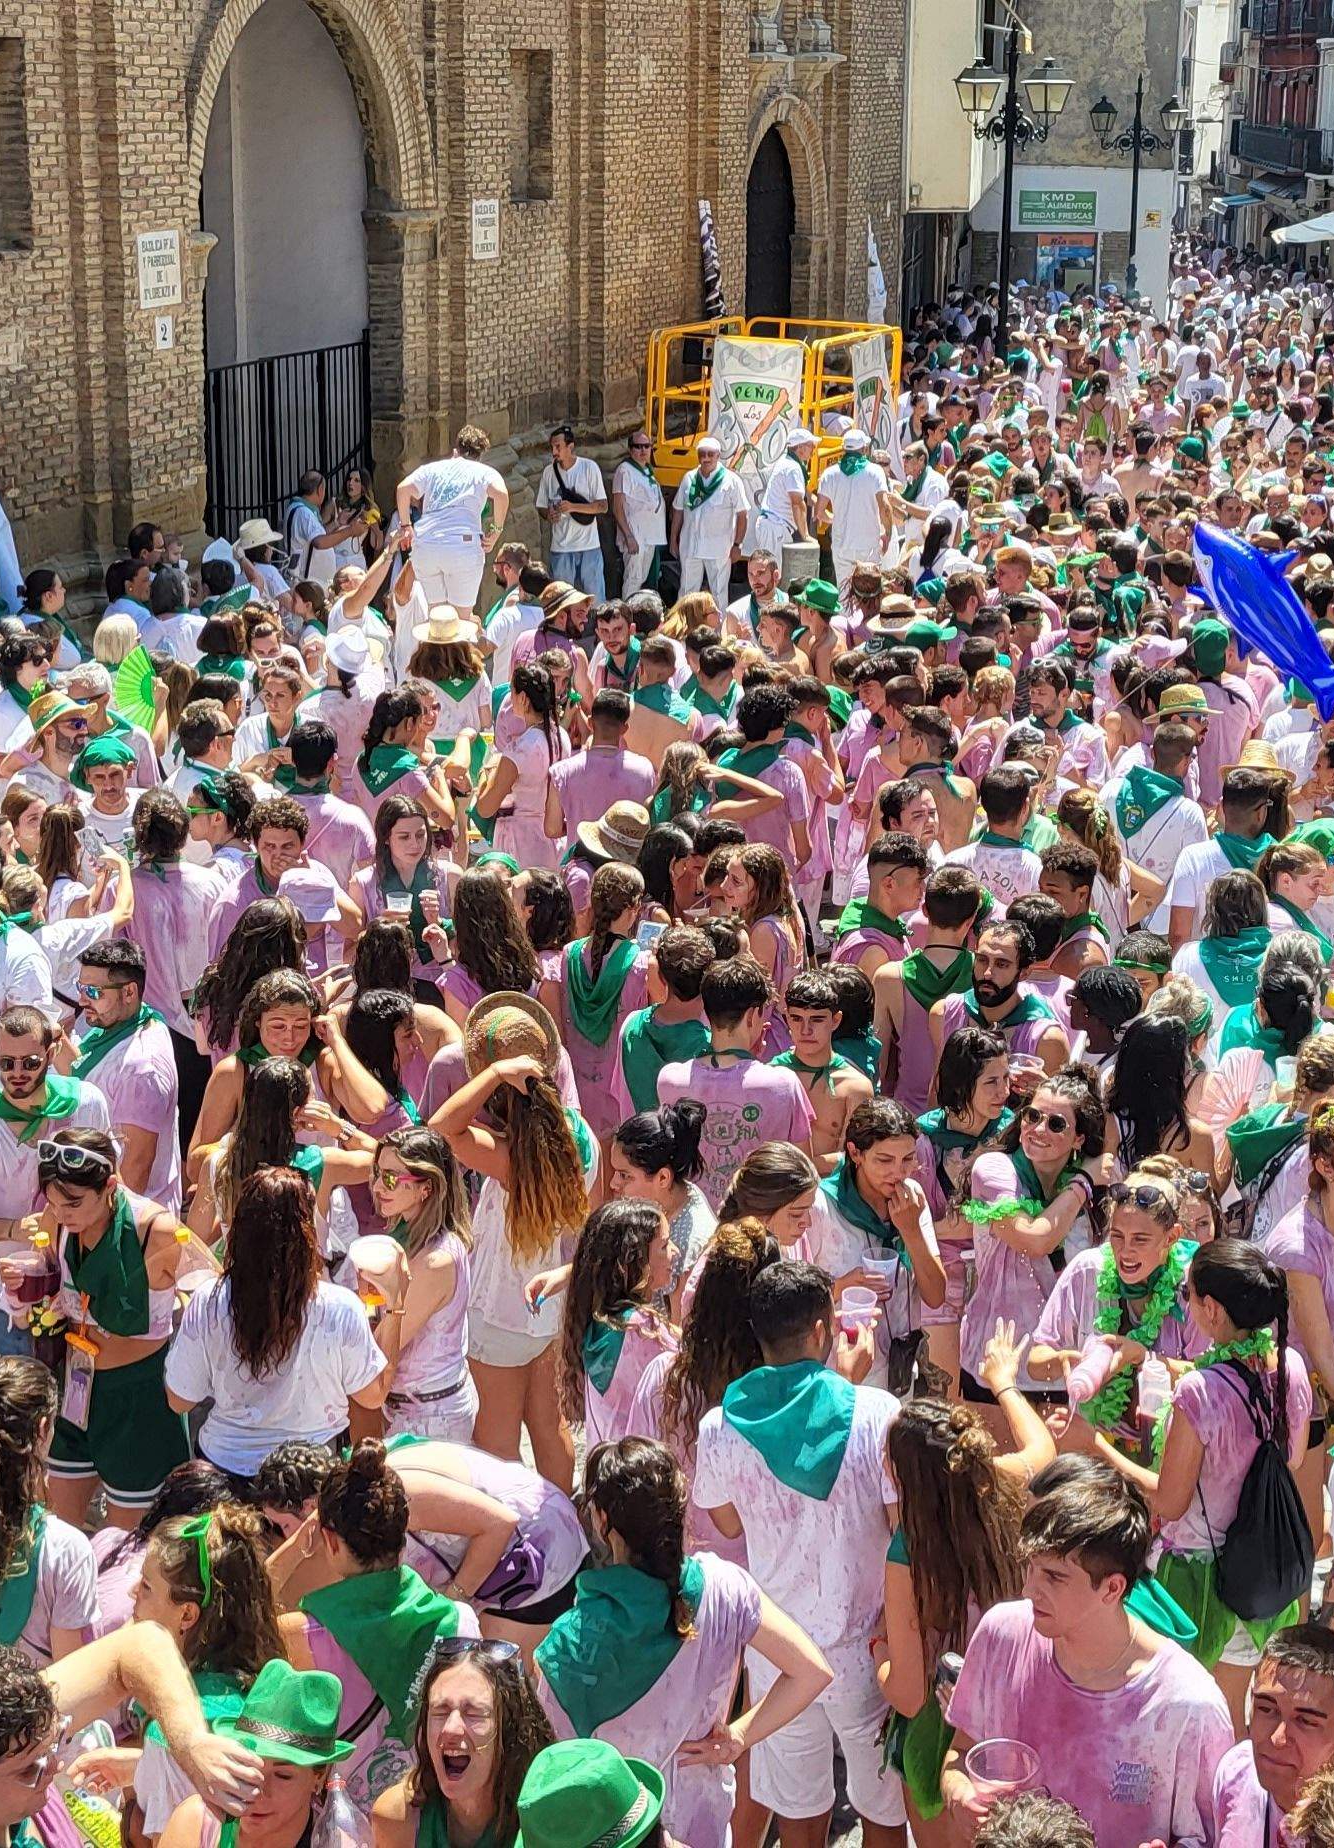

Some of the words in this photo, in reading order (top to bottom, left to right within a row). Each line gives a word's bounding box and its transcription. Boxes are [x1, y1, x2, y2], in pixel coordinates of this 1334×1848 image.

[1041, 193, 1075, 201] KMD
[1022, 211, 1055, 219] BEBIDAS
[1058, 211, 1093, 220] FRESCAS
[160, 323, 167, 341] 2
[734, 385, 775, 402] PEÑA
